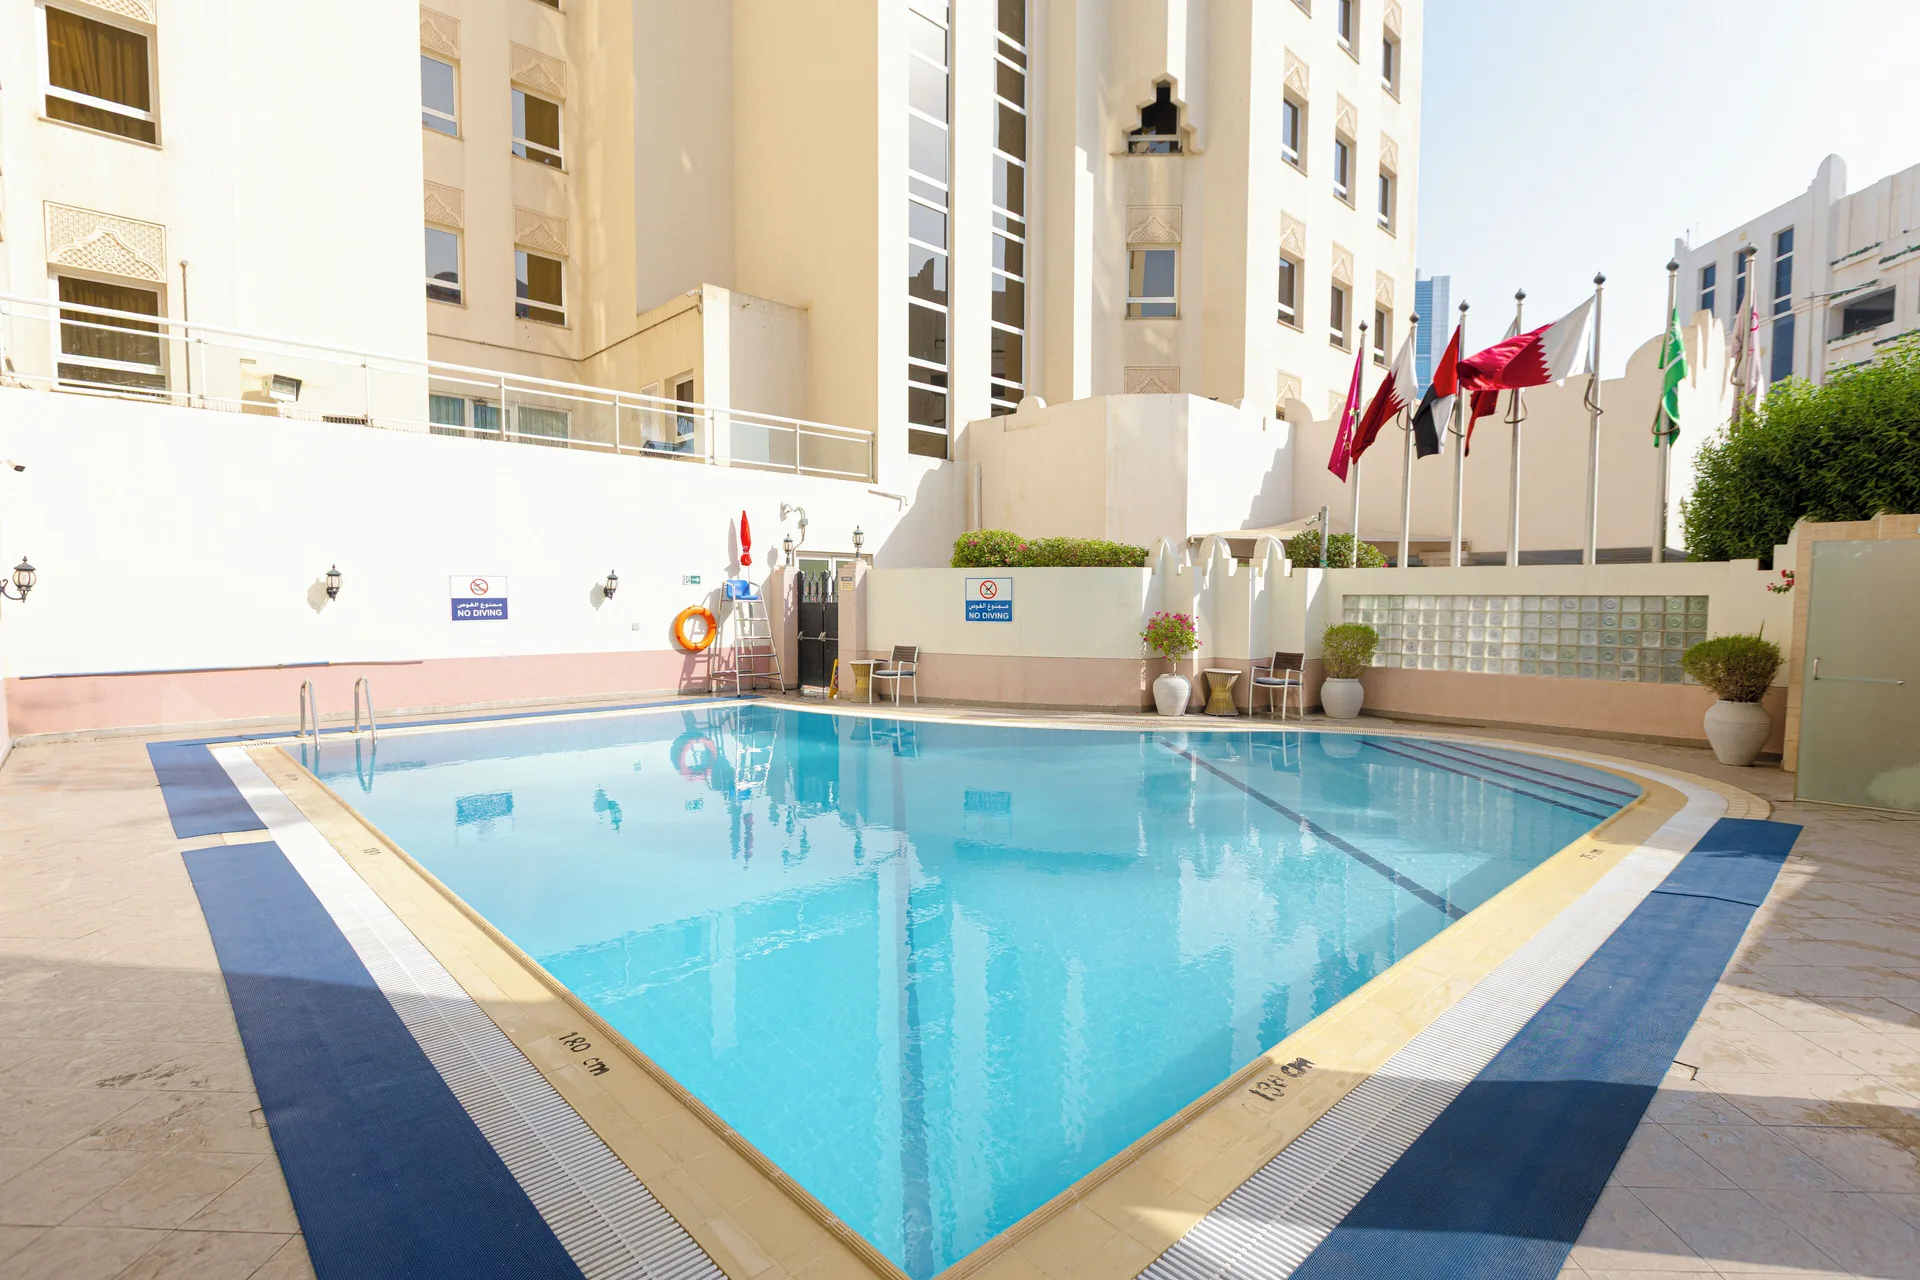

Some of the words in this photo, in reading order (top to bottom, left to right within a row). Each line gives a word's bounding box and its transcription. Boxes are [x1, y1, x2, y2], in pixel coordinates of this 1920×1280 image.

[456, 601, 479, 609] الغوص
[968, 602, 987, 610] الغوص
[986, 603, 1009, 611] ممنوع
[457, 609, 471, 617] NO
[473, 608, 503, 617] DIVING
[558, 1031, 592, 1053] 180
